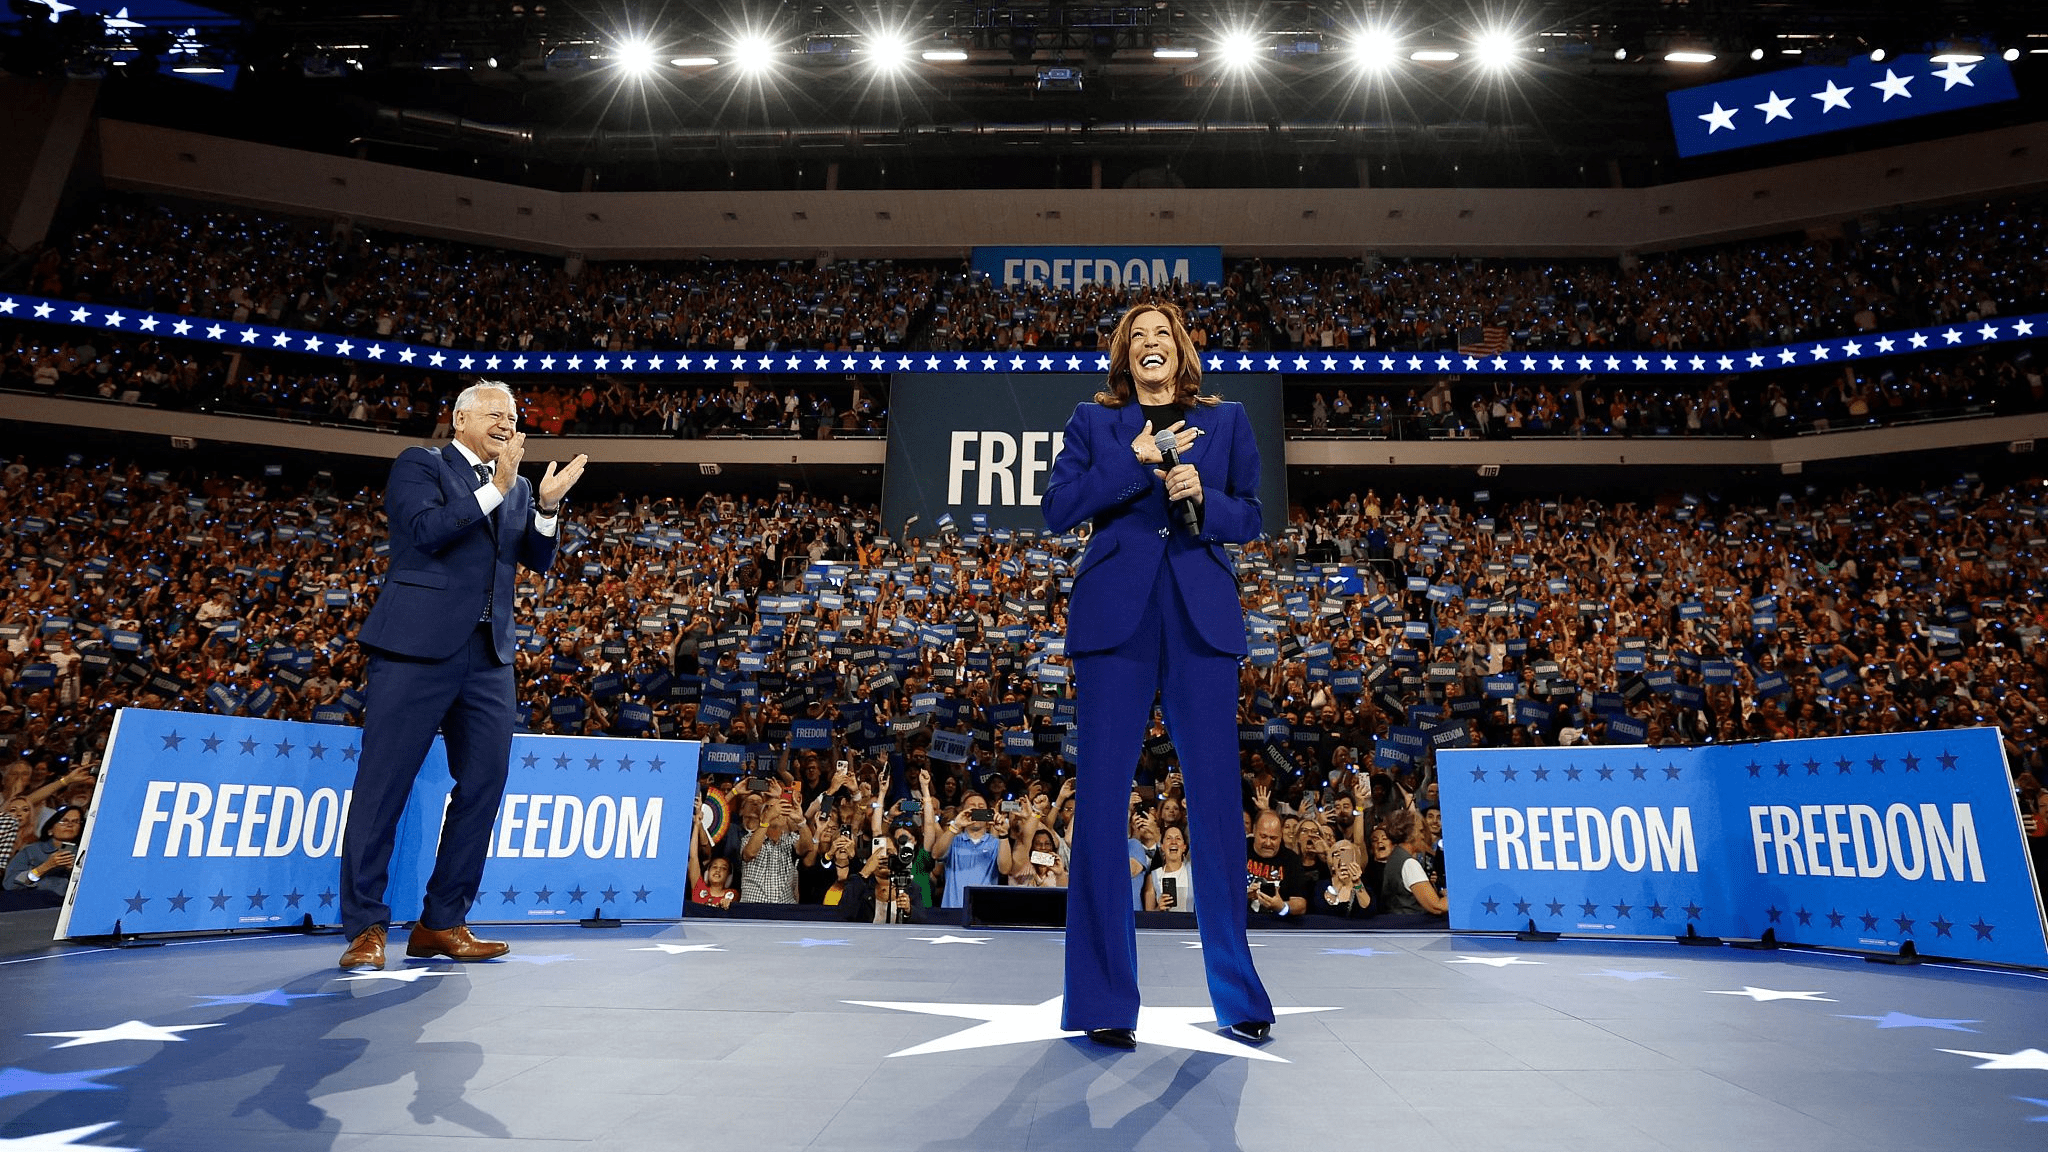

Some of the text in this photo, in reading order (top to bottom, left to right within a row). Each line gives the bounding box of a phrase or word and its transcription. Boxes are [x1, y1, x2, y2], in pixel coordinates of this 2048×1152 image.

[702, 465, 716, 475] 116
[947, 431, 1065, 506] FRE
[1484, 466, 1498, 477] 118
[1383, 615, 1403, 623] FREEDOM
[853, 649, 875, 660] FREEDOM
[1252, 647, 1275, 656] FREEDOM
[933, 667, 954, 677] FREEDOM
[1041, 668, 1064, 677] FREEDOM
[1430, 668, 1456, 676] FREEDOM
[871, 675, 894, 690] FREEDOM
[1334, 677, 1359, 686] FREEDOM
[1487, 682, 1514, 691] FREEDOM
[671, 686, 697, 696] FREEDOM
[622, 709, 650, 722] FREEDOM
[703, 705, 731, 719] FREEDOM
[893, 720, 921, 731] FREEDOM
[1612, 720, 1644, 737] FREEDOM
[796, 727, 827, 738] FREEDOM
[1432, 726, 1465, 745] FREEDOM
[1393, 733, 1423, 746] FREEDOM
[934, 739, 947, 753] WE
[947, 742, 967, 757] WIN
[707, 752, 740, 763] FREEDOM
[1266, 744, 1293, 774] FREEDOM
[1380, 747, 1410, 764] FREEDOM
[436, 793, 663, 859] EEDOM
[1471, 806, 1698, 873] FREEDOM
[1749, 803, 1987, 883] FREEDOM
